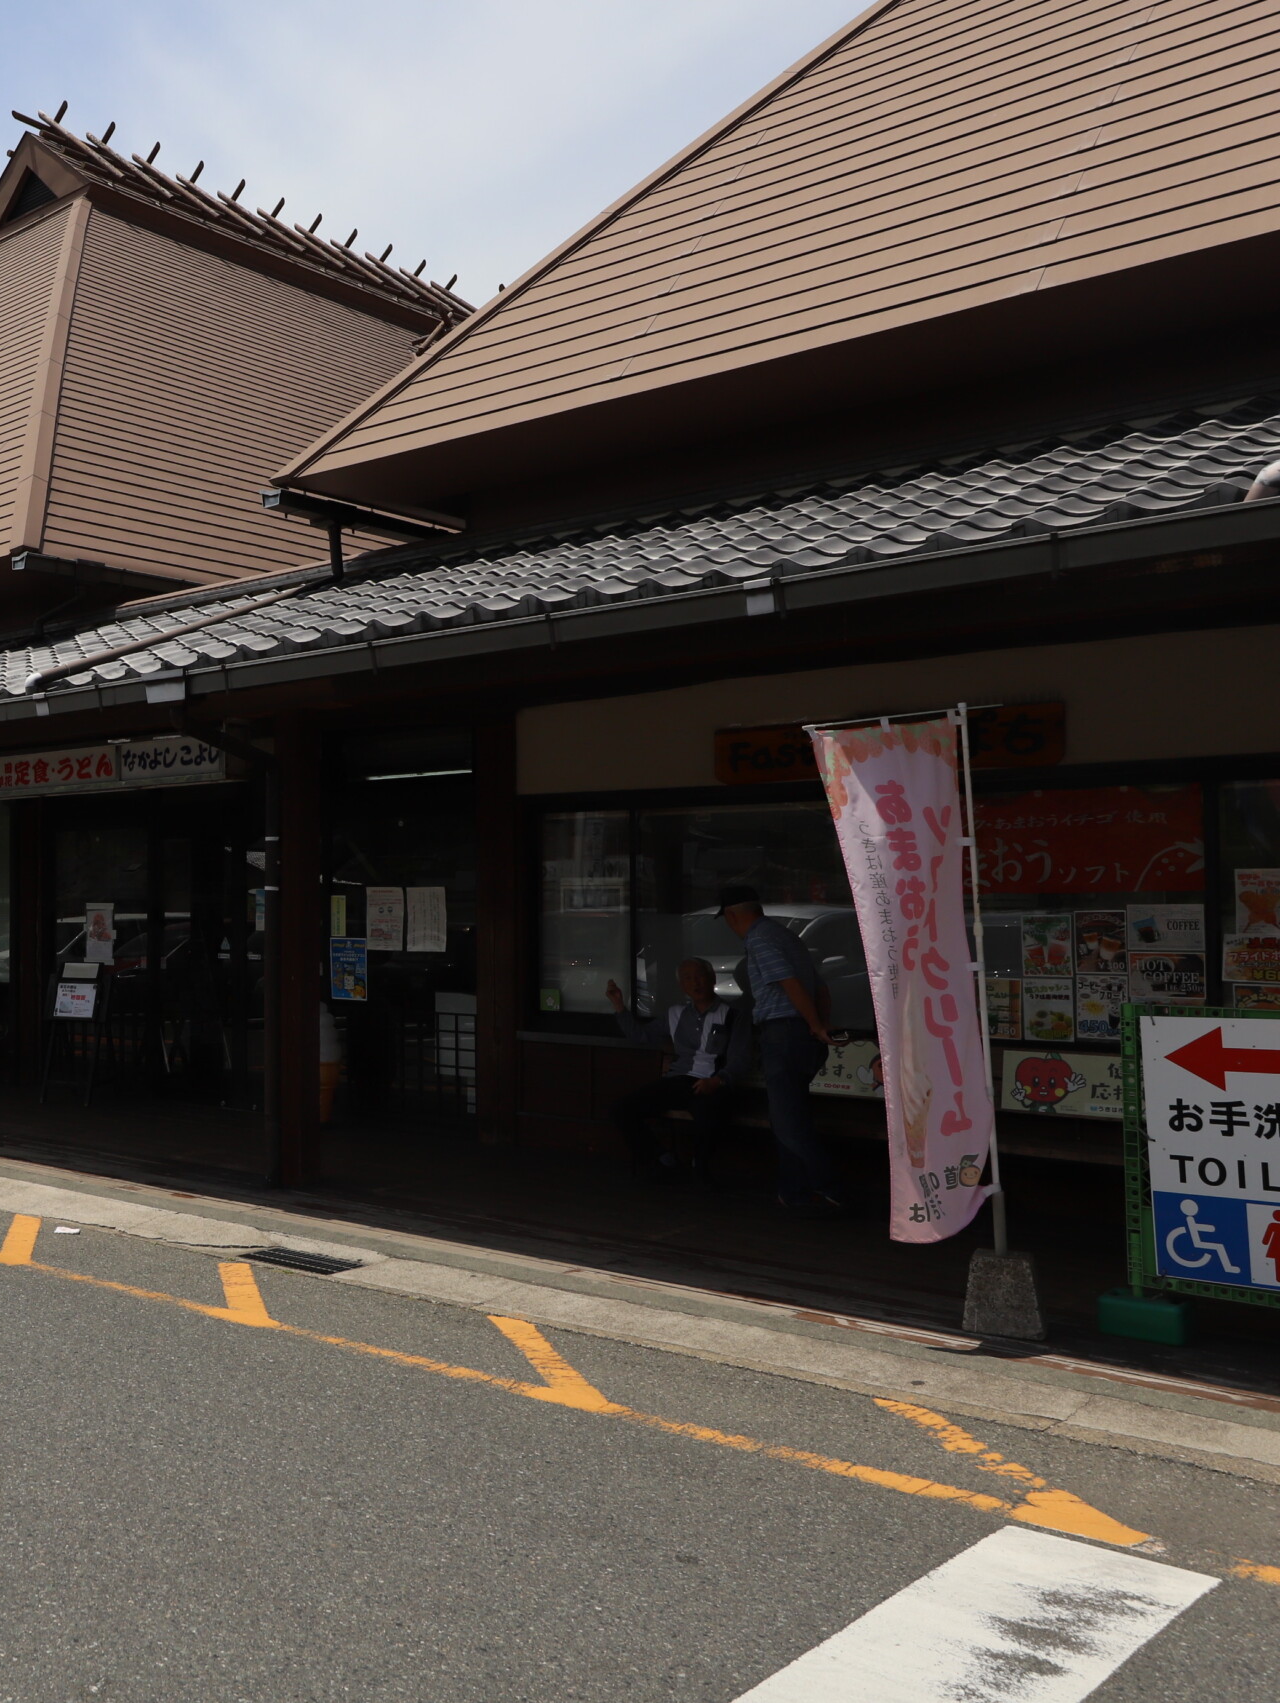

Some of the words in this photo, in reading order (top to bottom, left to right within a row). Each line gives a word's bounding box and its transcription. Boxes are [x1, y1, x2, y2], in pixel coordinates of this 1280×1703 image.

[1125, 810, 1168, 824] 使用
[1166, 919, 1200, 931] COFFEE
[1136, 959, 1166, 972] HOT
[1143, 971, 1201, 984] COFFEE
[1100, 991, 1126, 1001] フロート
